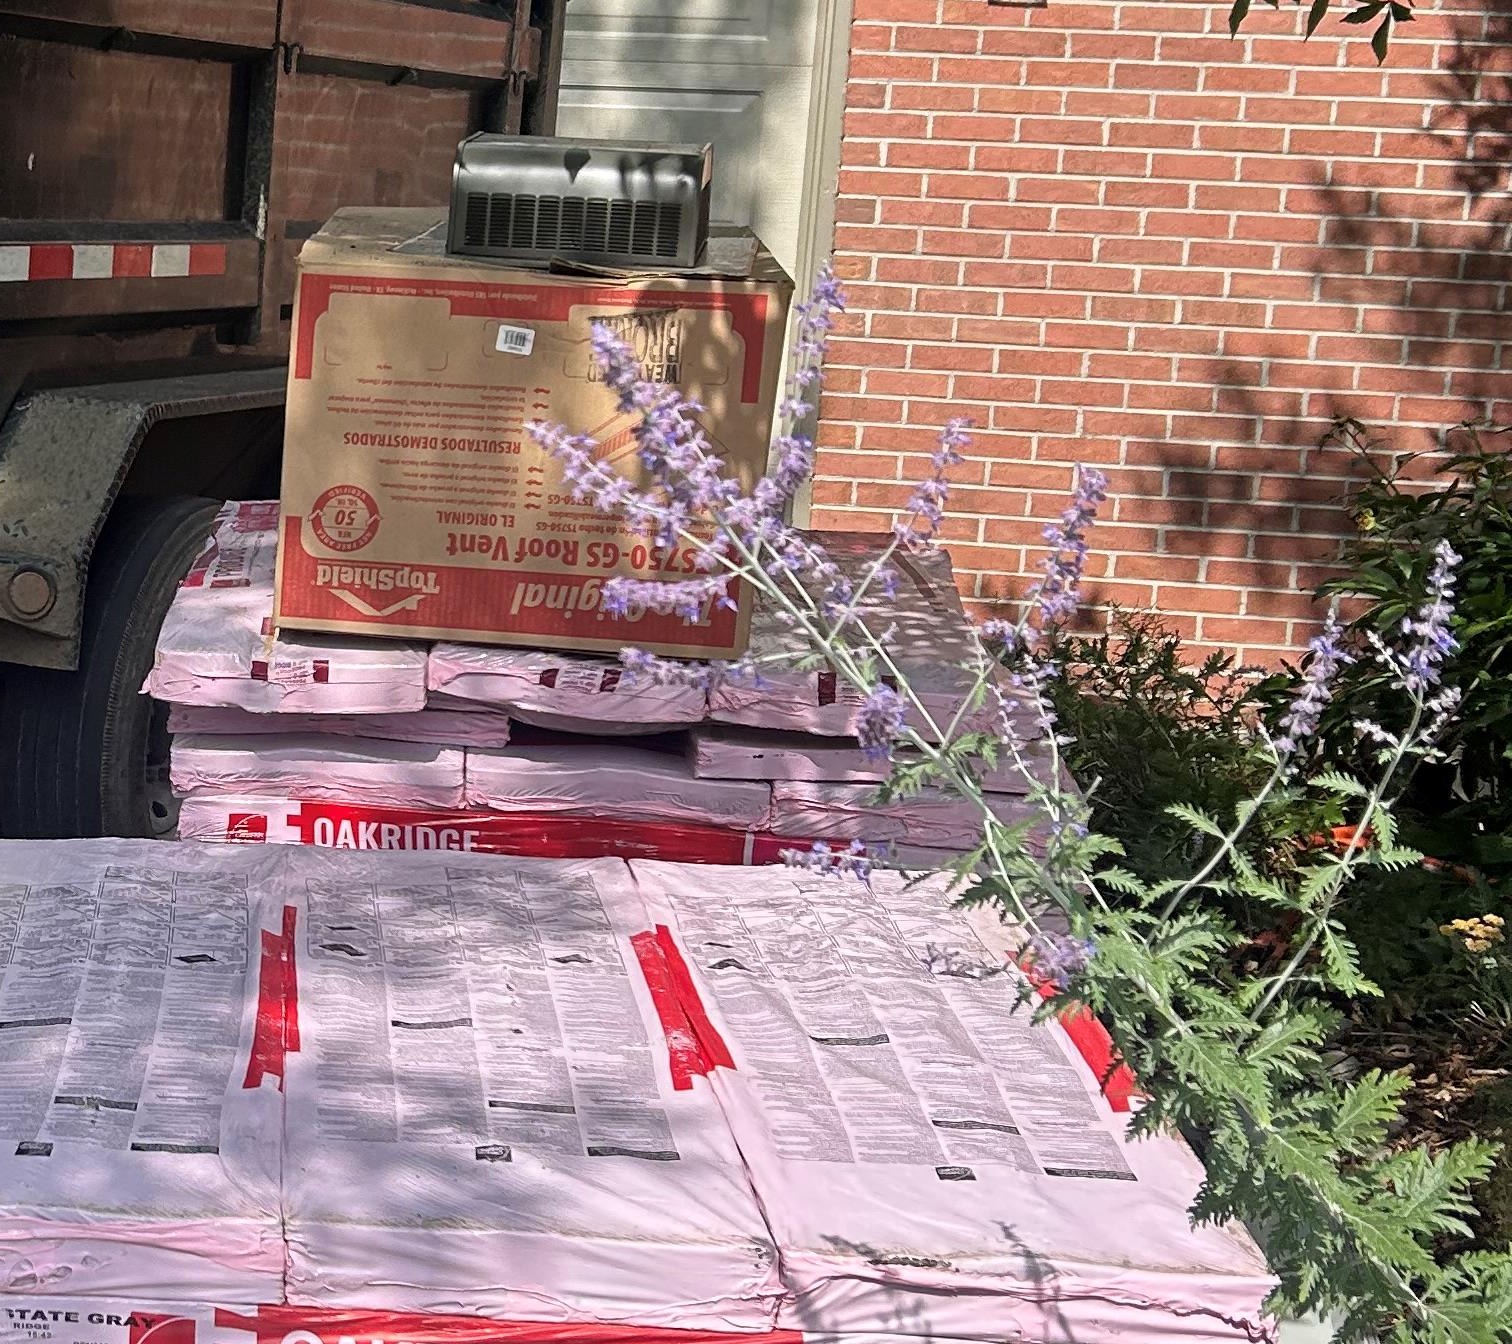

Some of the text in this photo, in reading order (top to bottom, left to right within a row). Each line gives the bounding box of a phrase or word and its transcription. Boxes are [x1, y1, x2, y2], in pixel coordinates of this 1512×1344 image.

[343, 431, 521, 454] RESULTADOS DEMOSTRADOS
[334, 509, 358, 527] 50
[436, 510, 515, 528] EL ORIGINAL
[446, 532, 510, 562] Vent
[514, 535, 580, 567] Roof
[316, 564, 441, 595] TopShield
[87, 1312, 156, 1329] GRAY
